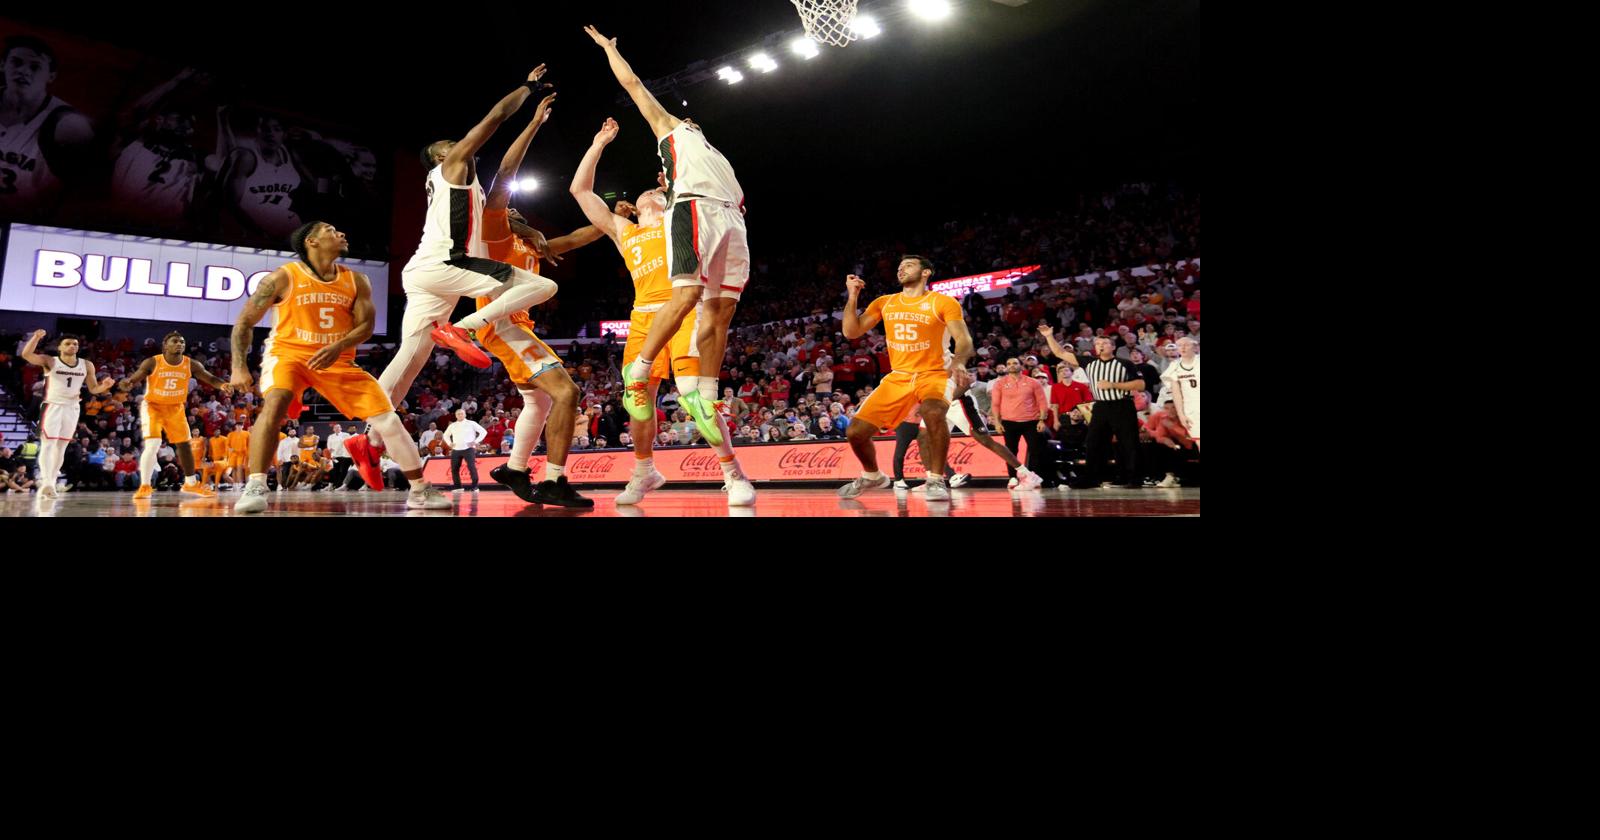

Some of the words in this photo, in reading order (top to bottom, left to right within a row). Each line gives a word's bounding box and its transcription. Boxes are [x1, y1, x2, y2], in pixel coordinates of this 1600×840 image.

[631, 246, 642, 266] 3
[319, 307, 335, 329] 5
[885, 311, 931, 325] TENNESSEE
[894, 323, 918, 341] 25
[66, 376, 72, 388] 1
[164, 378, 178, 390] 15
